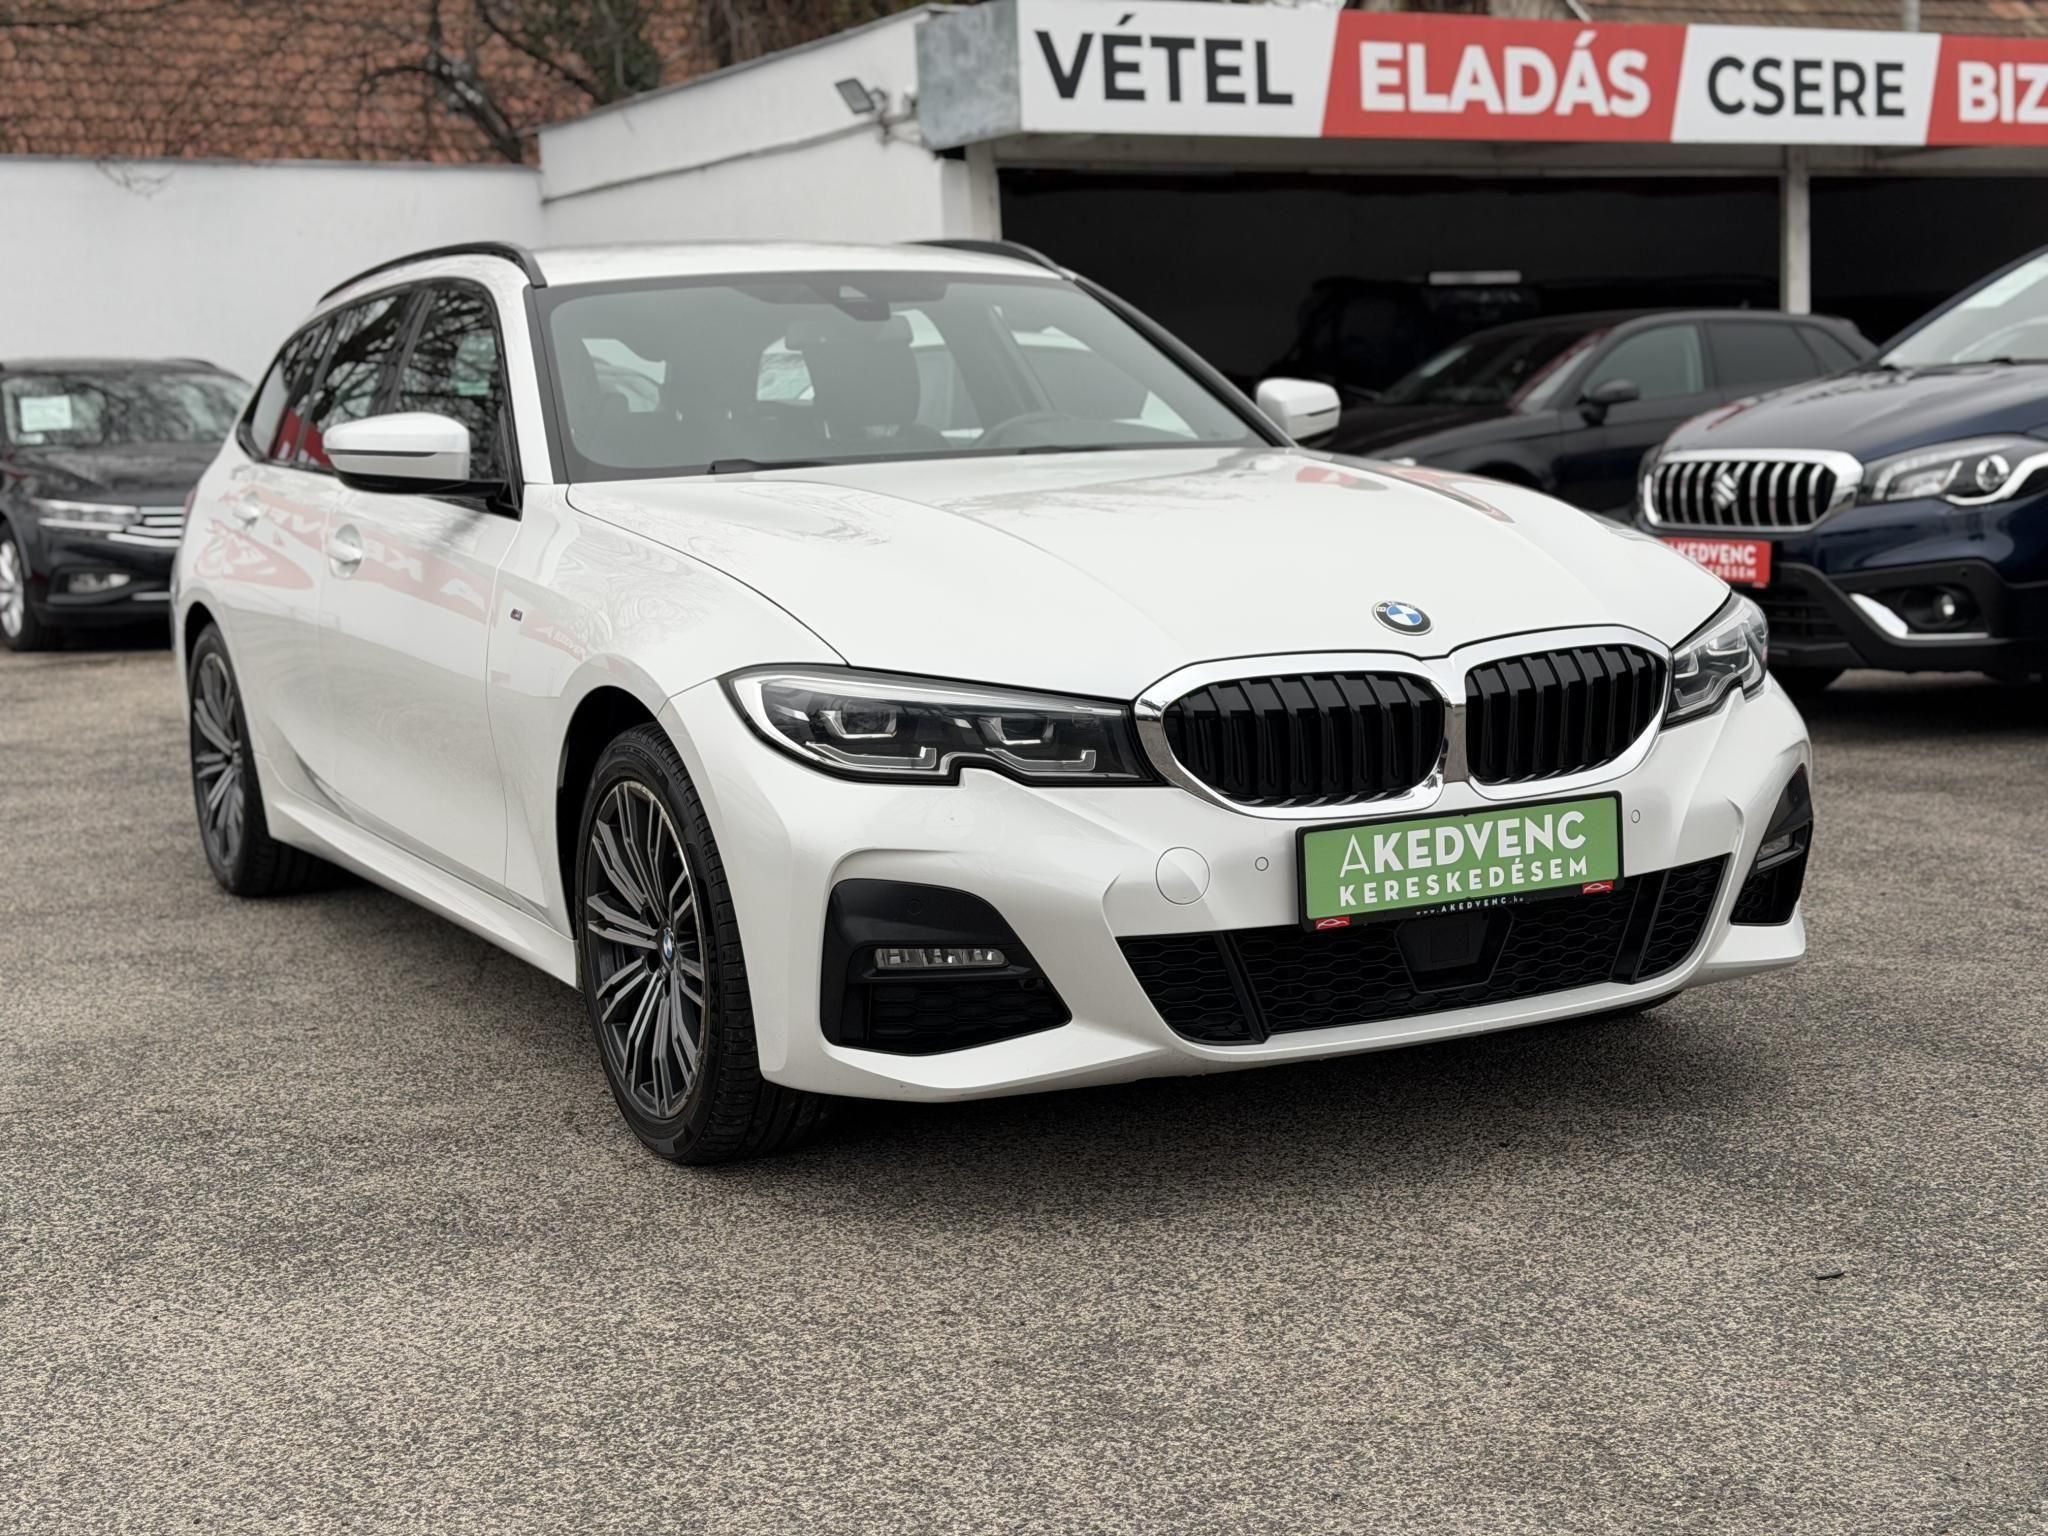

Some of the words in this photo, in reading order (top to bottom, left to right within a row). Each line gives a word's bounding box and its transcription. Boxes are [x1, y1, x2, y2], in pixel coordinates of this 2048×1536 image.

[1035, 14, 1294, 105] VÉTEL
[1359, 31, 1651, 118] ELADÁS
[1707, 56, 1905, 117] CSERE
[1958, 60, 2048, 124] BIZ
[1339, 810, 1587, 878] AKEDVENC
[1339, 855, 1588, 907] KERESKEDÉSEM
